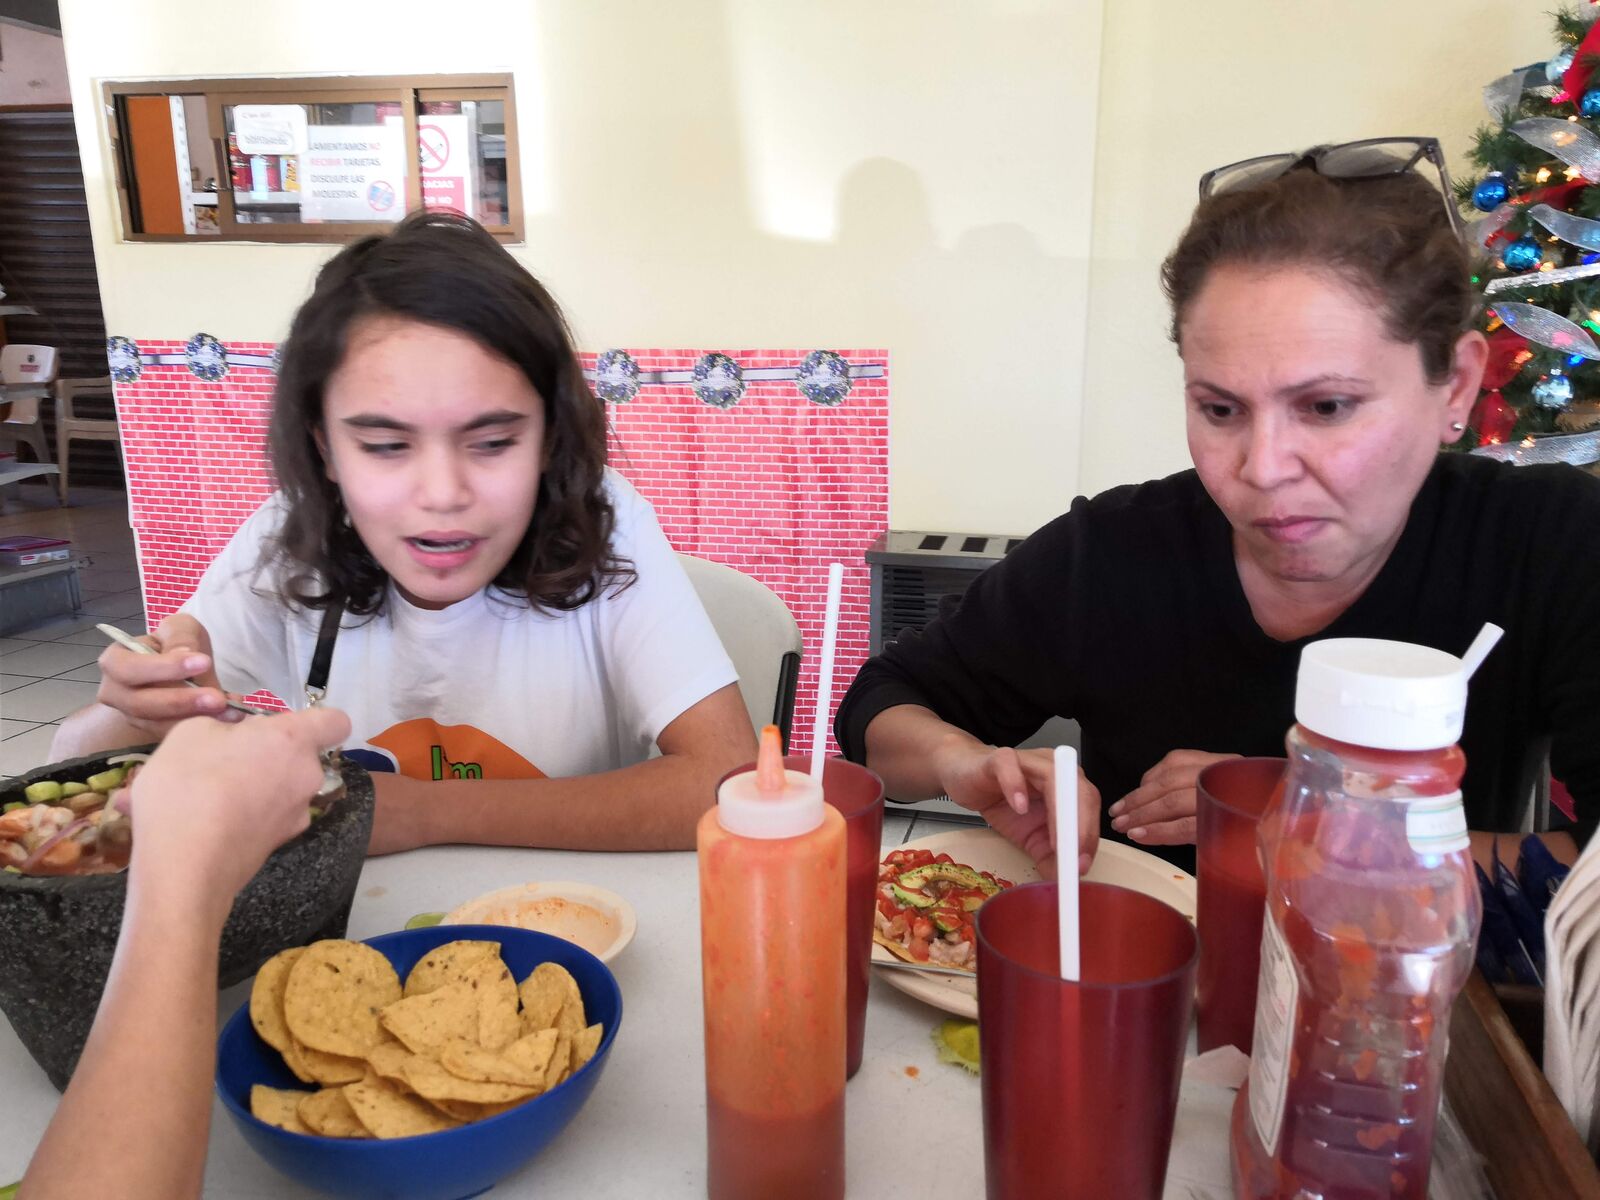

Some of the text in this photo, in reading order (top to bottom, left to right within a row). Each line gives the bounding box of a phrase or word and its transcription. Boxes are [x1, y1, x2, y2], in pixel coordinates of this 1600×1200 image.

[310, 157, 341, 167] RECIBIR
[310, 174, 365, 184] DISCULPE LAS
[423, 180, 455, 189] ACIAS
[423, 195, 453, 205] OR NO
